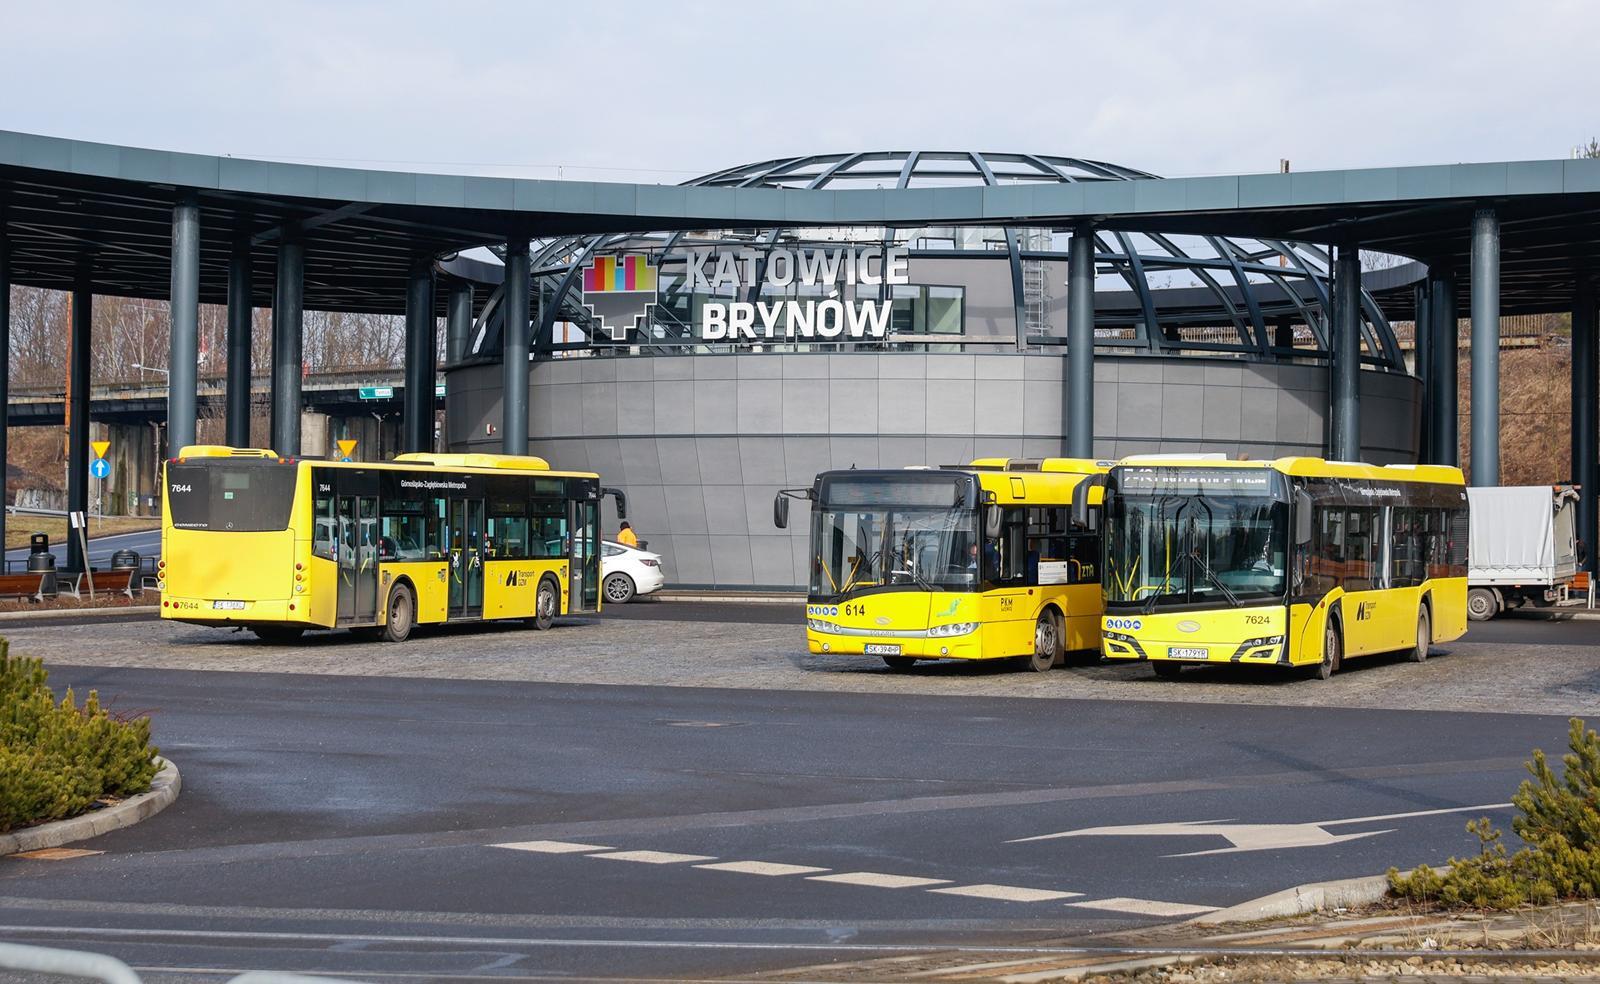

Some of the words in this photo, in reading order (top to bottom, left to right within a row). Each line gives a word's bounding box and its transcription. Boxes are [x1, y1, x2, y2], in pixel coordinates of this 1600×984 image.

[685, 247, 909, 288] KATOWICE
[702, 289, 893, 340] BRYNÓW
[171, 484, 192, 493] 7644
[319, 484, 331, 492] 7644
[179, 601, 199, 609] 7644
[845, 604, 865, 616] 614
[1245, 615, 1270, 624] 7624
